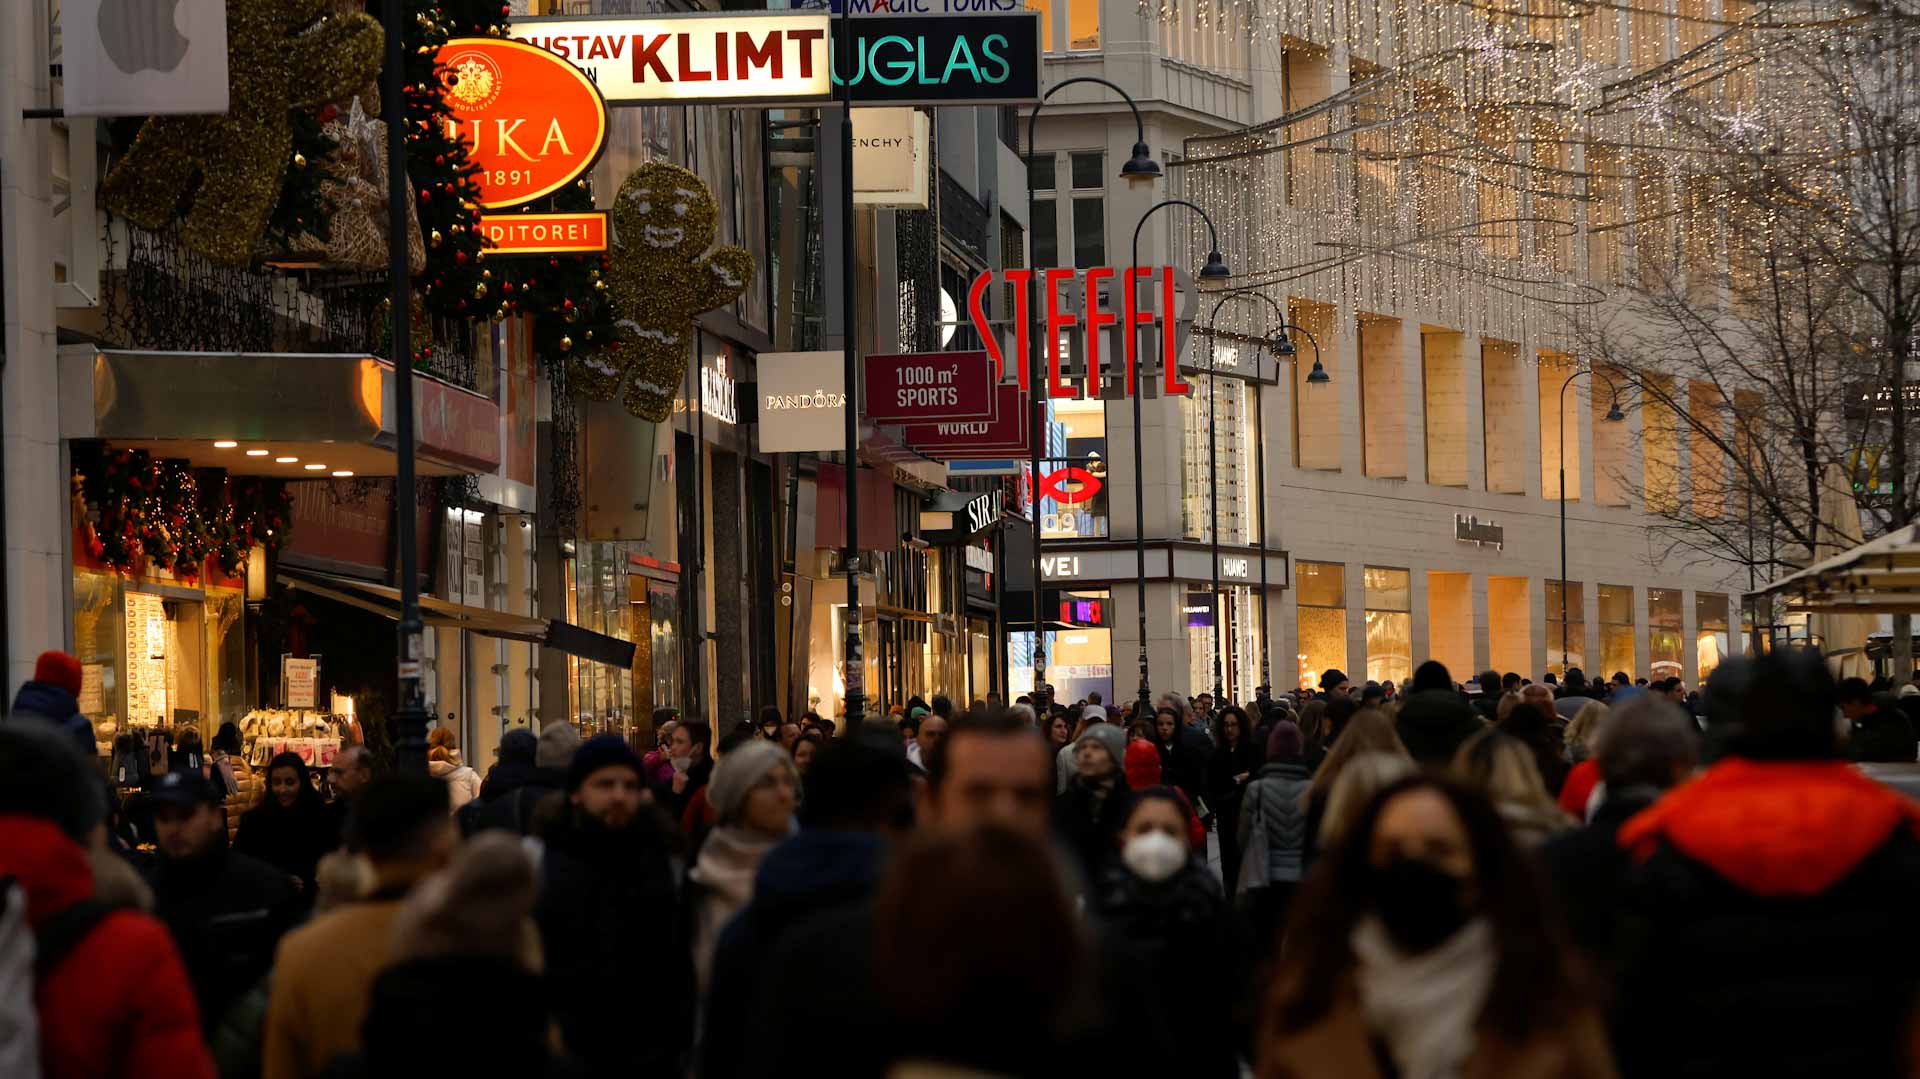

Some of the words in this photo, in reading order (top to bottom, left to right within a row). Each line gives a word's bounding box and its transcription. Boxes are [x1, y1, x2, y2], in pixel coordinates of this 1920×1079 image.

[632, 29, 824, 83] KLIMT
[831, 33, 1010, 86] UGLAS
[447, 117, 575, 163] UKA
[850, 137, 903, 149] ENCHY
[483, 170, 531, 186] 1891
[968, 265, 1190, 397] STEFFL
[895, 366, 934, 387] 1000
[896, 386, 959, 408] SPORTS
[967, 493, 992, 534] SIR
[1032, 556, 1080, 577] WEI
[1222, 557, 1248, 578] HUAWEI
[1182, 605, 1210, 614] HUAWEI
